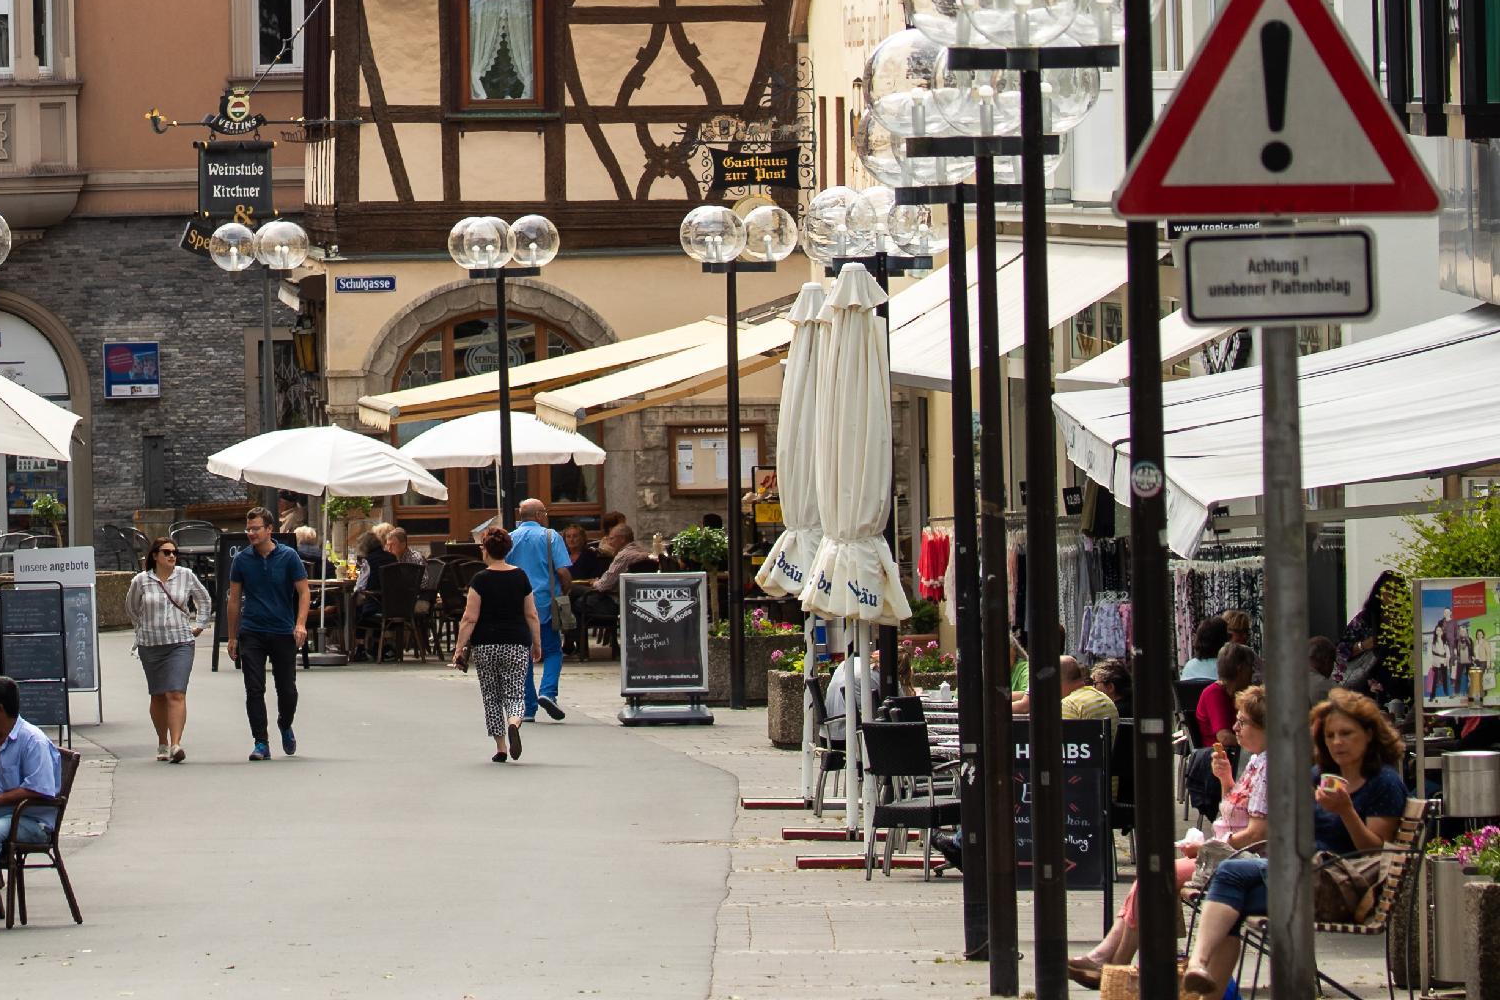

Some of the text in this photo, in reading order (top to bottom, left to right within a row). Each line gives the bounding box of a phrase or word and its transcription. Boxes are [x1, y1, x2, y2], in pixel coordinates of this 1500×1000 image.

[218, 117, 257, 130] VELTINS
[722, 155, 789, 169] Gasthaus
[207, 163, 264, 176] Weinstube
[724, 167, 787, 182] zur Post
[212, 185, 261, 198] Kirchner
[234, 204, 254, 225] &
[1248, 258, 1300, 275] Achtung
[339, 278, 391, 291] Schulgasse
[1208, 278, 1351, 298] unebener Plattenbelag
[19, 560, 90, 573] unsere angebote
[638, 588, 690, 600] TROPICS
[632, 608, 693, 623] Jeans Mode
